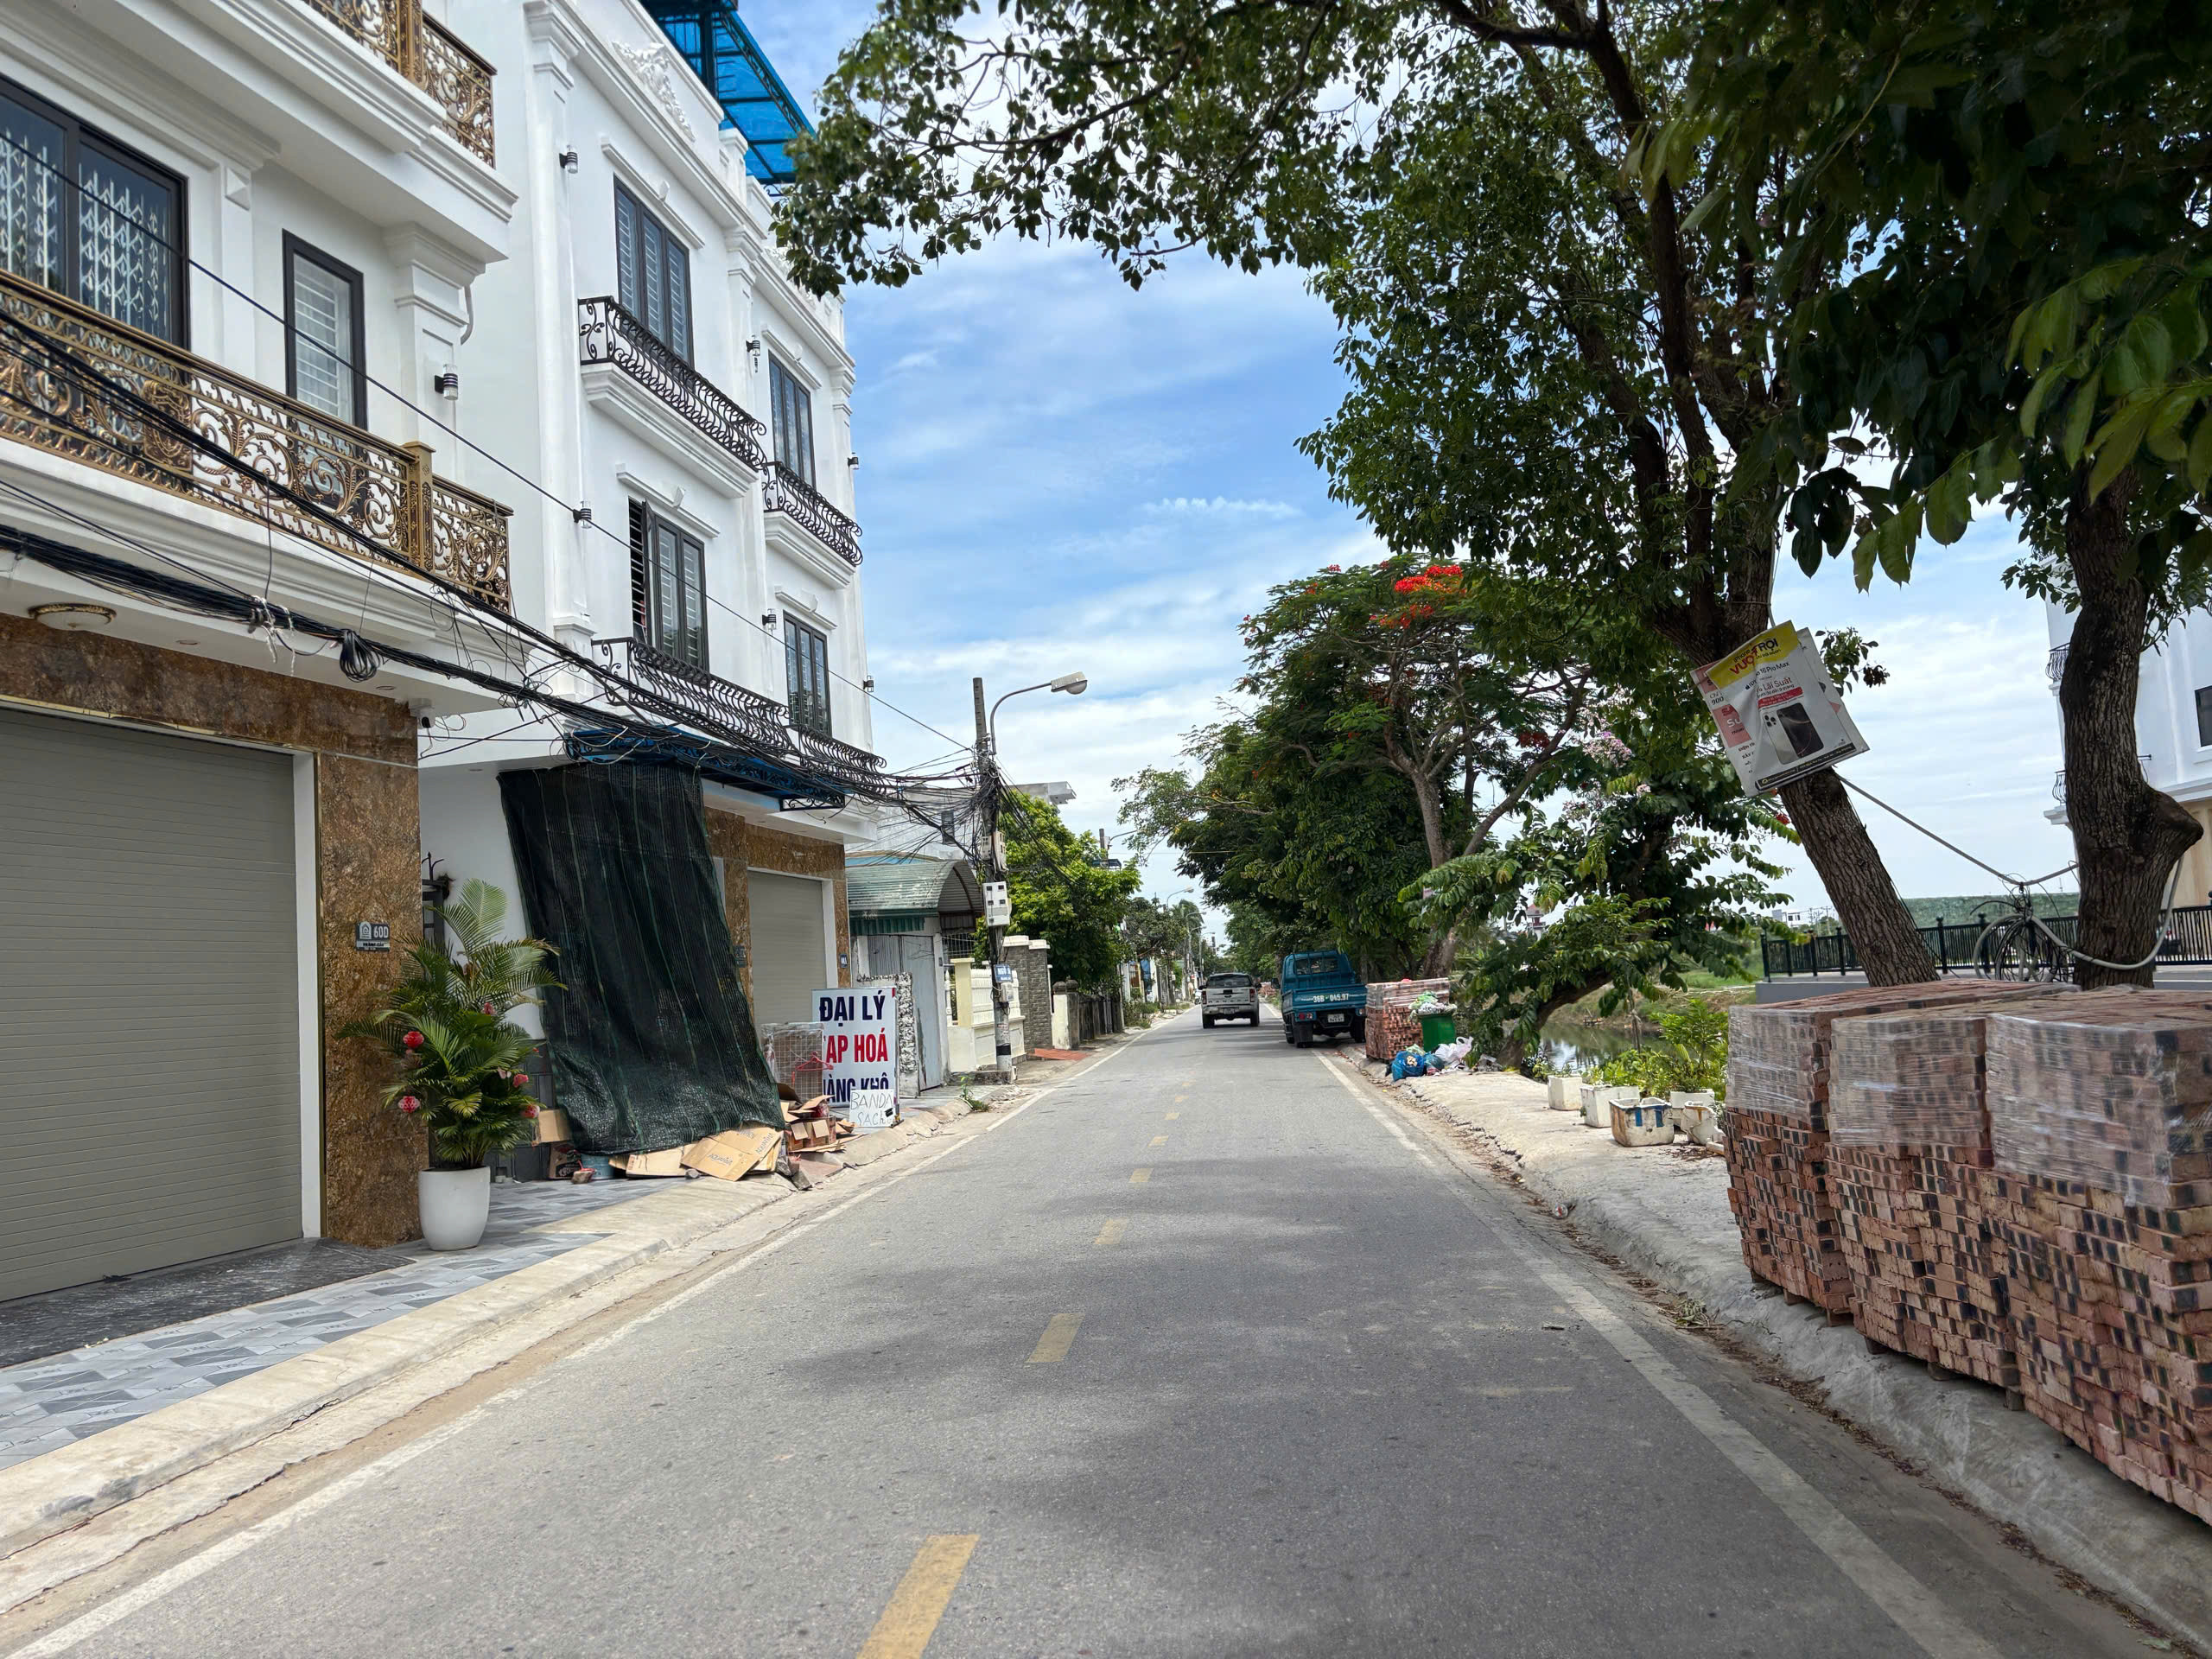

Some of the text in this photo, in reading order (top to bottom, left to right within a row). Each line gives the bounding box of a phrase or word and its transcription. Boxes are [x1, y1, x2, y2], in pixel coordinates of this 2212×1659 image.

[373, 925, 389, 938] 60D
[819, 990, 886, 1027] ĐẠI LÝ
[854, 1027, 888, 1063] HOÁ
